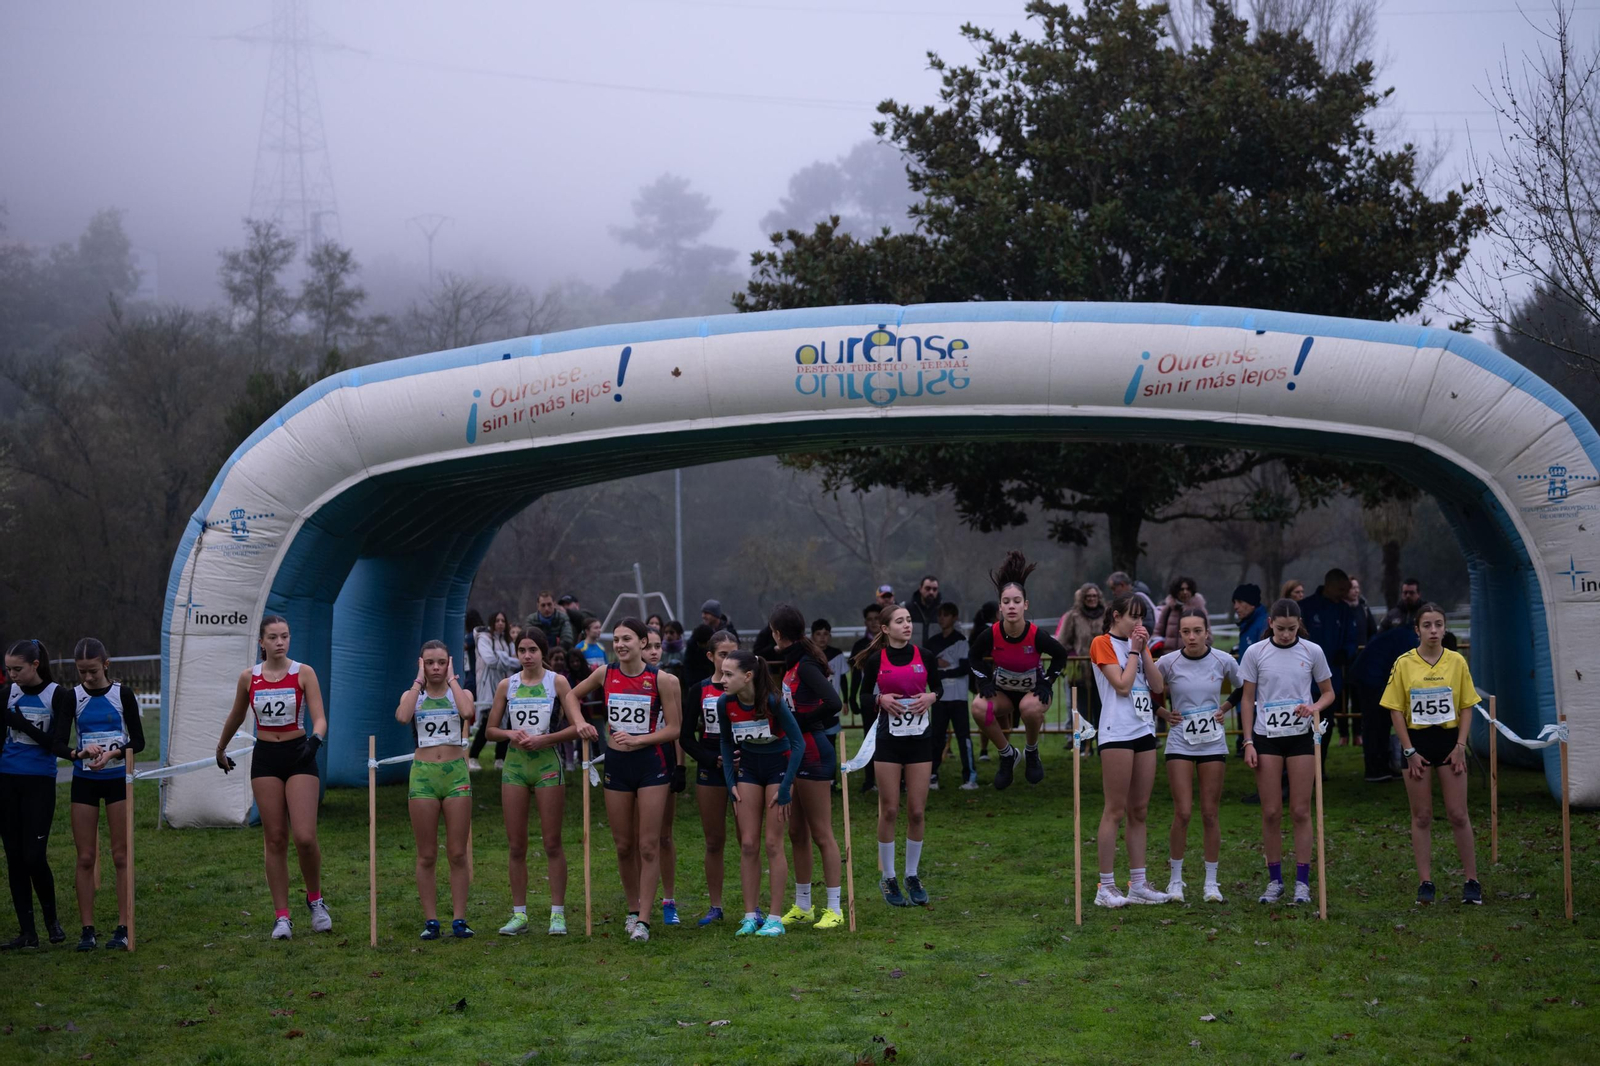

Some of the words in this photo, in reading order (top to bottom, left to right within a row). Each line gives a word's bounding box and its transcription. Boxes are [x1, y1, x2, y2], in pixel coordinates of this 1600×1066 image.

[796, 365, 845, 374] DESTINO
[920, 359, 969, 370] TERMAL
[1143, 380, 1172, 397] sin
[1178, 377, 1192, 393] ir
[1196, 371, 1236, 391] más
[1241, 367, 1287, 387] lejos
[482, 414, 508, 433] sin
[513, 408, 525, 423] ir
[529, 395, 566, 418] más
[570, 380, 612, 404] lejos
[195, 611, 248, 625] inorde
[998, 674, 1033, 688] 398
[261, 701, 286, 717] 42
[609, 706, 646, 724] 528
[1412, 698, 1451, 716] 455
[516, 710, 540, 726] 95
[1185, 716, 1218, 735] 421
[1266, 711, 1304, 728] 422
[424, 720, 451, 737] 94
